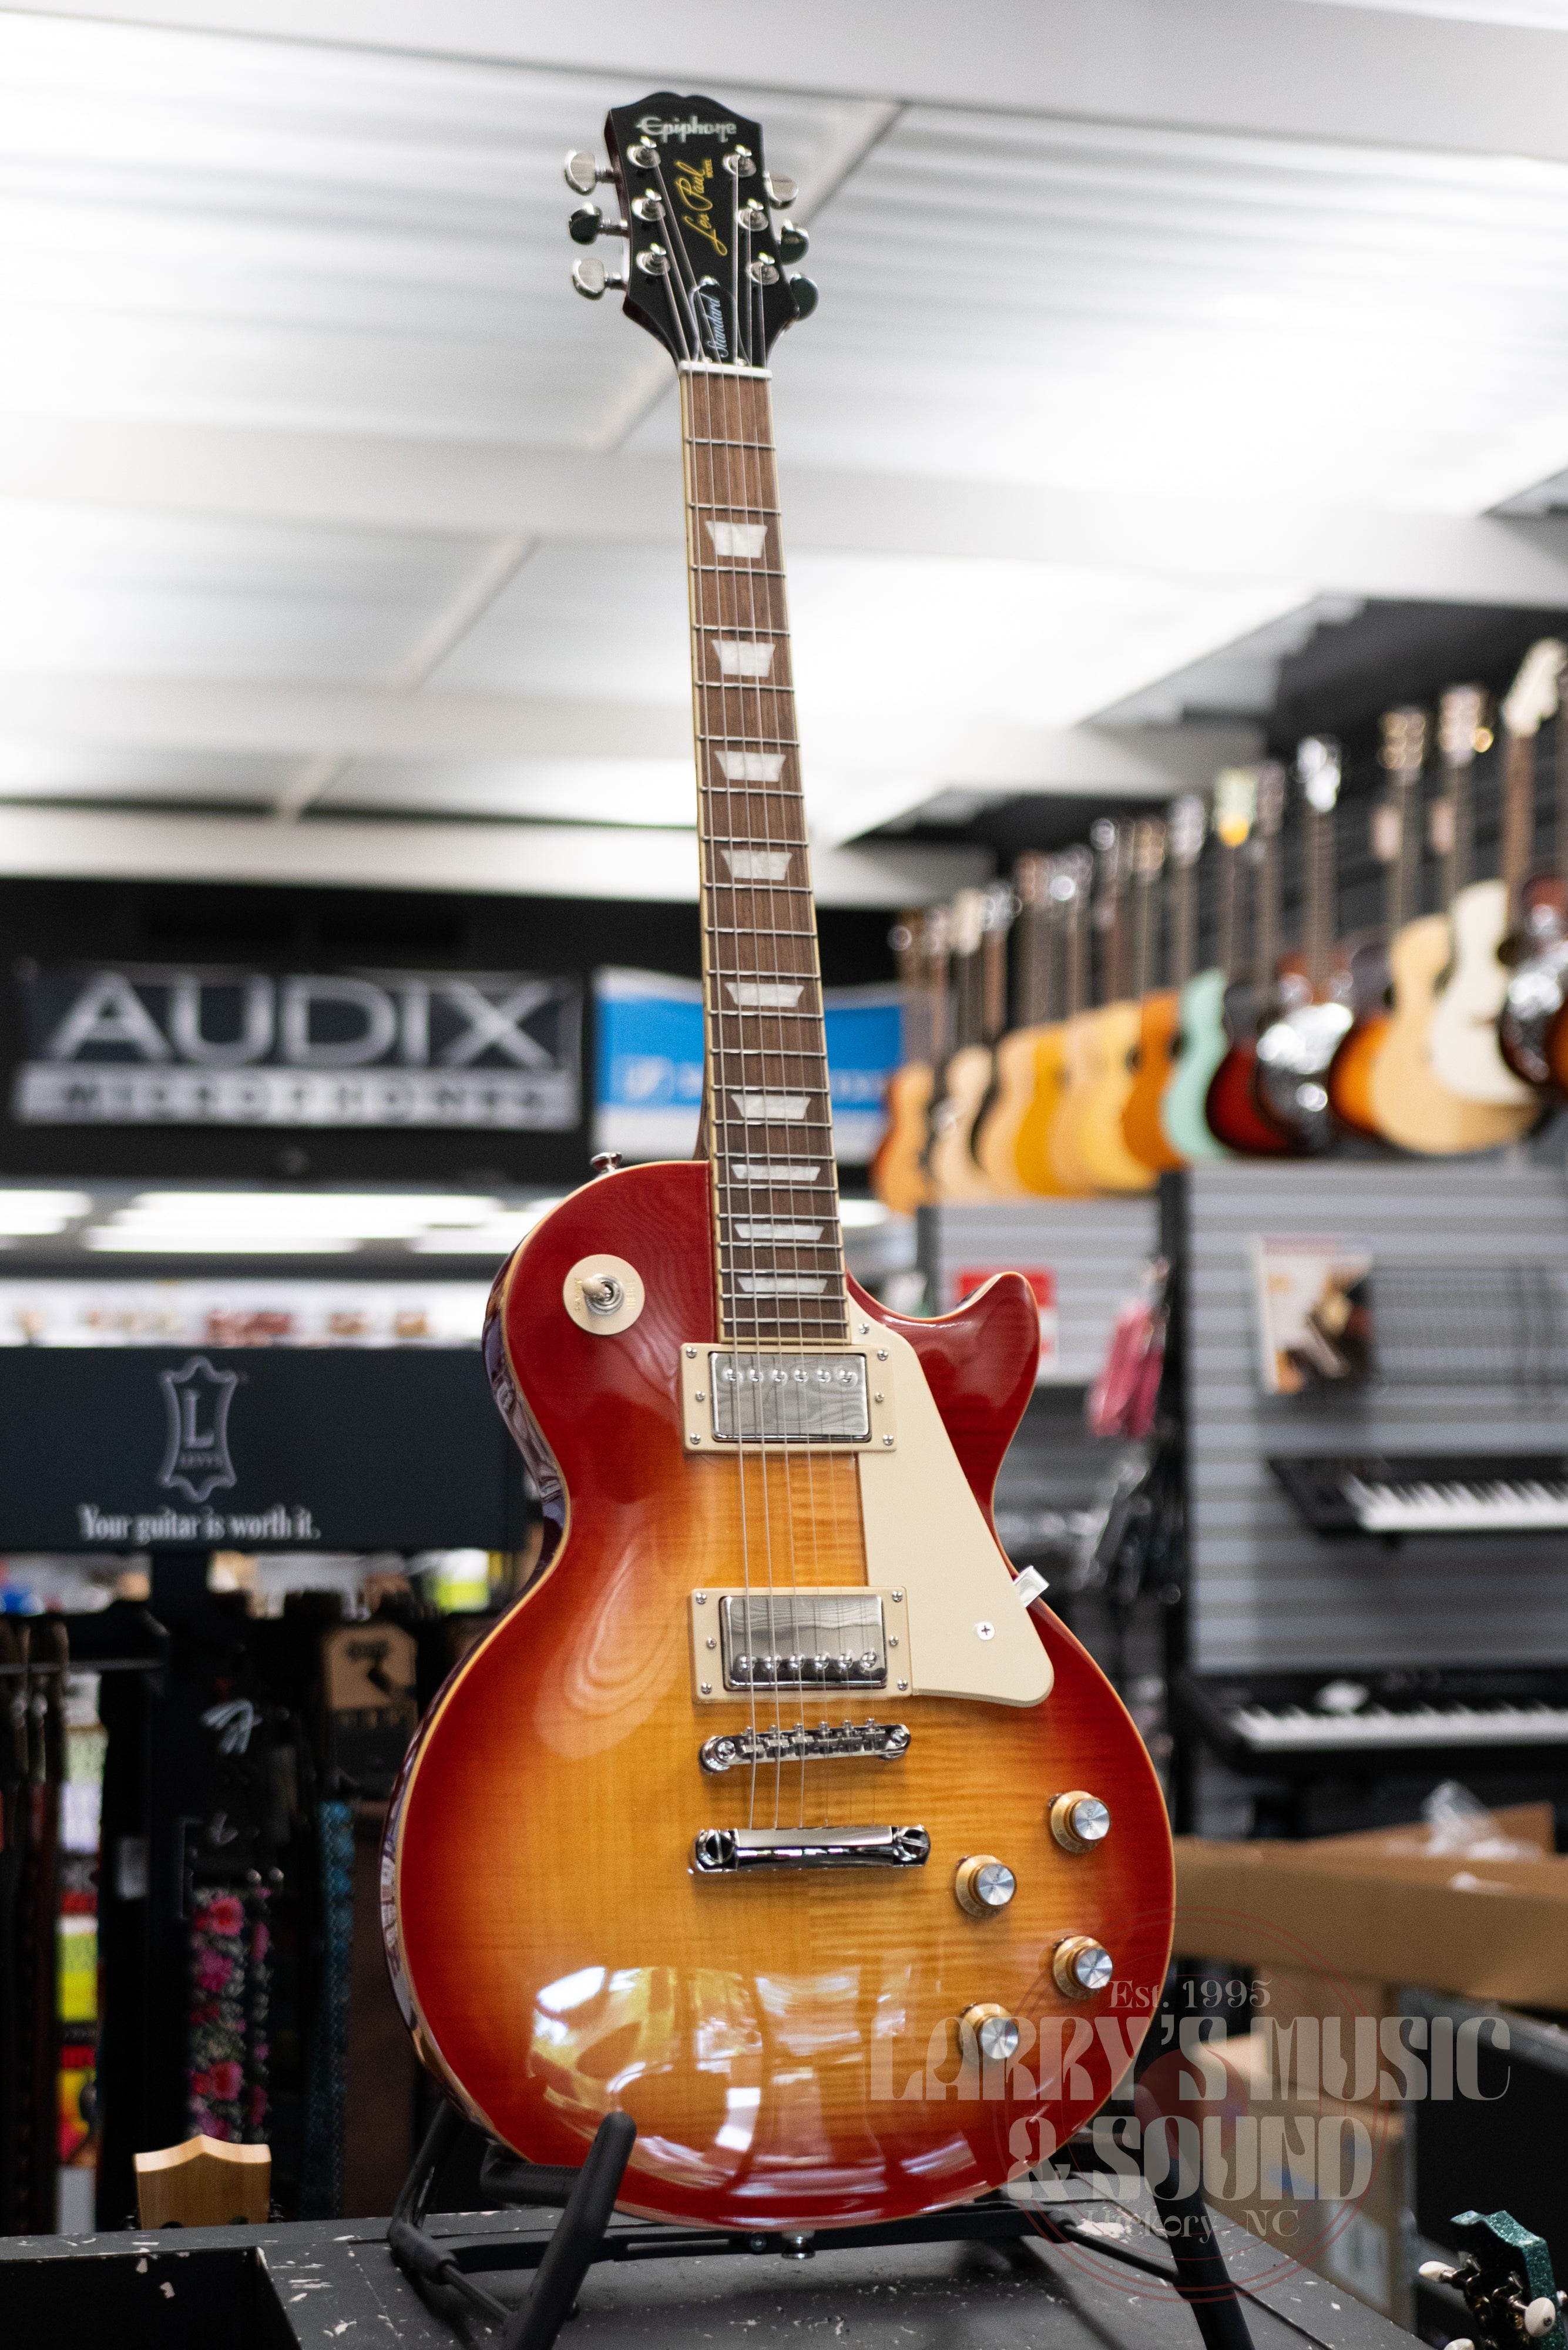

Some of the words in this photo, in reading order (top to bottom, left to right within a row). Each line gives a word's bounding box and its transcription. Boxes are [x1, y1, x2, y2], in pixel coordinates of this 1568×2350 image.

[636, 115, 737, 143] Epiphone
[674, 160, 713, 212] Paul
[682, 213, 728, 256] Les
[699, 293, 729, 358] Standard
[47, 971, 556, 1068] AUDIX
[78, 1503, 132, 1541] Your
[134, 1504, 202, 1547] guitar
[201, 1504, 226, 1541] is
[230, 1502, 292, 1541] worth
[294, 1504, 321, 1541] it.
